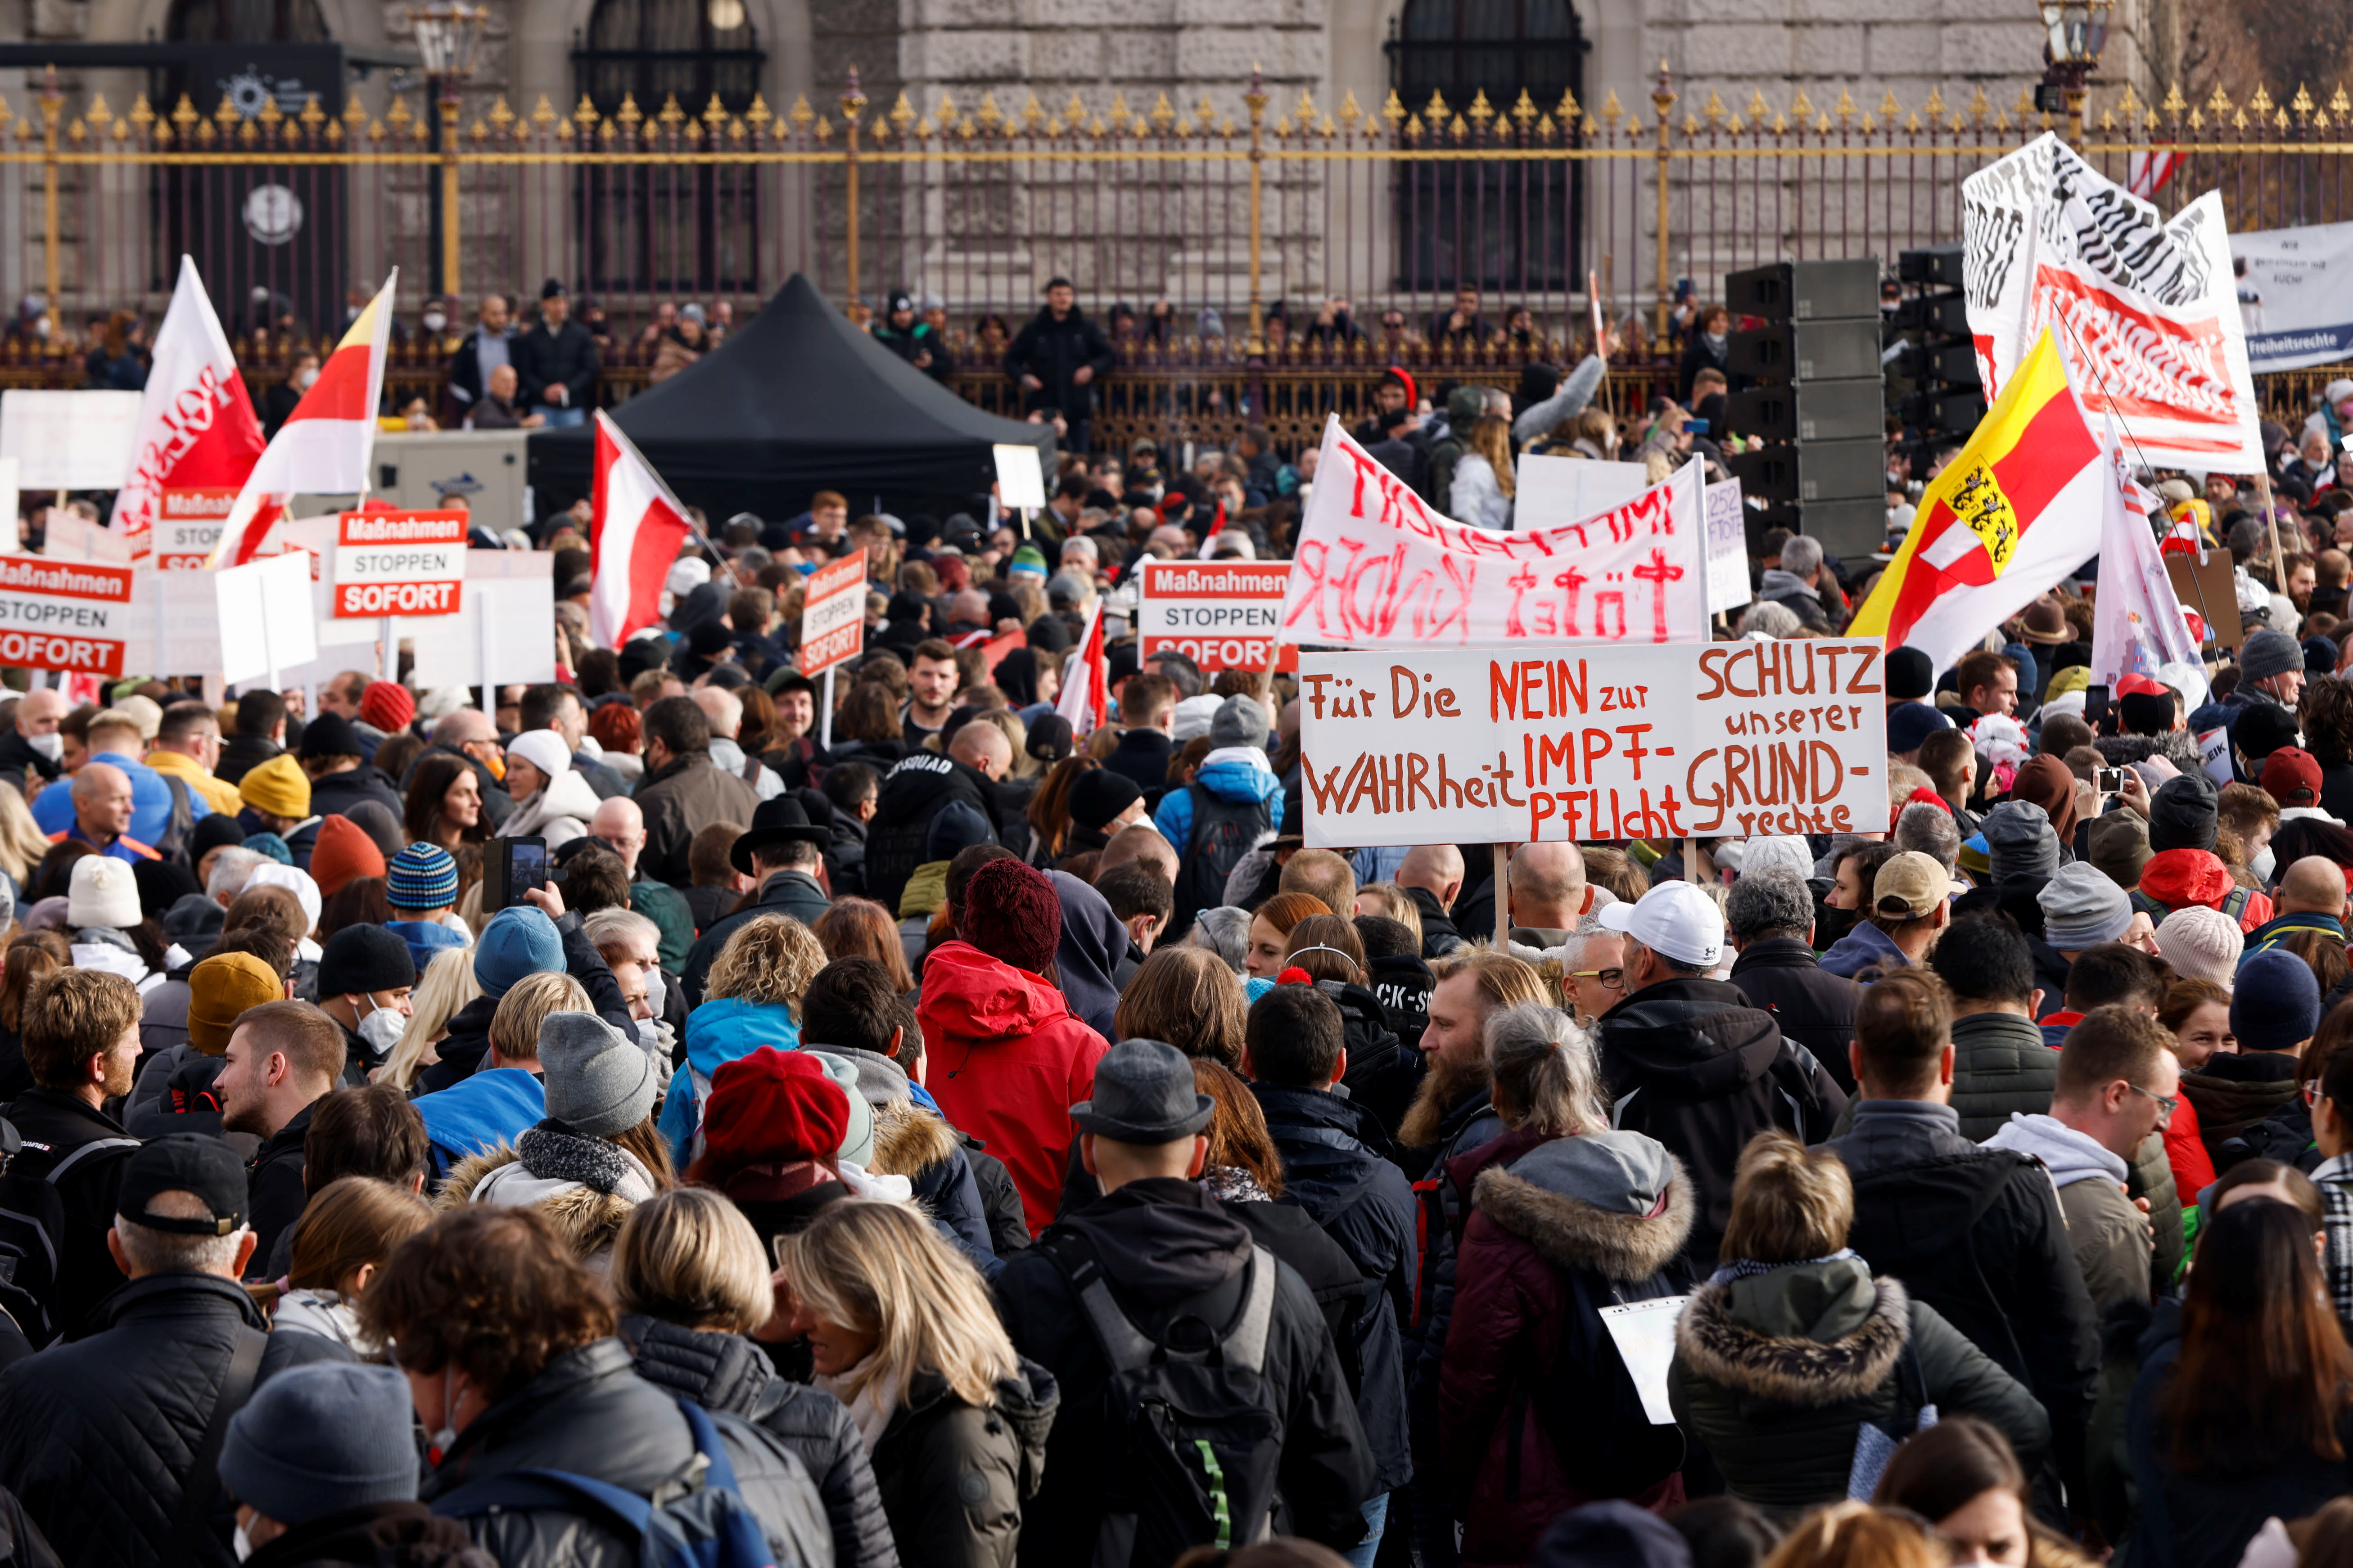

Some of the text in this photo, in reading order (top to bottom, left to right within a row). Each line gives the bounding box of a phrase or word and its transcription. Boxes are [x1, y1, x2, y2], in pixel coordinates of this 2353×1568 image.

[2281, 241, 2299, 250] WIR
[2249, 332, 2337, 355] Freiheitsrechte
[167, 493, 235, 515] Maßnah
[347, 516, 460, 540] Maßnahmen
[1708, 515, 1744, 543] FTOTE
[354, 553, 447, 572] STOPPEN
[808, 561, 863, 600] Maßnahmen
[1155, 570, 1287, 592] Maßnahmen
[344, 583, 455, 612] SOFORT
[811, 596, 855, 630] STOPPEN
[1166, 608, 1276, 626] STOPPEN
[0, 633, 115, 668] OFORT
[805, 622, 858, 669] SOFORT
[1697, 642, 1882, 701] SCHUTZ
[1303, 665, 1461, 720] Für Die
[1490, 658, 1648, 723] NEIN zur
[1725, 704, 1862, 735] unserer
[1524, 723, 1675, 788] IMPF-
[2207, 742, 2226, 762] EIK
[1301, 751, 1527, 815] WAHRheit
[1686, 740, 1869, 831] GRUND-
[1736, 803, 1853, 836] rechte
[21, 1140, 45, 1150] BURTO
